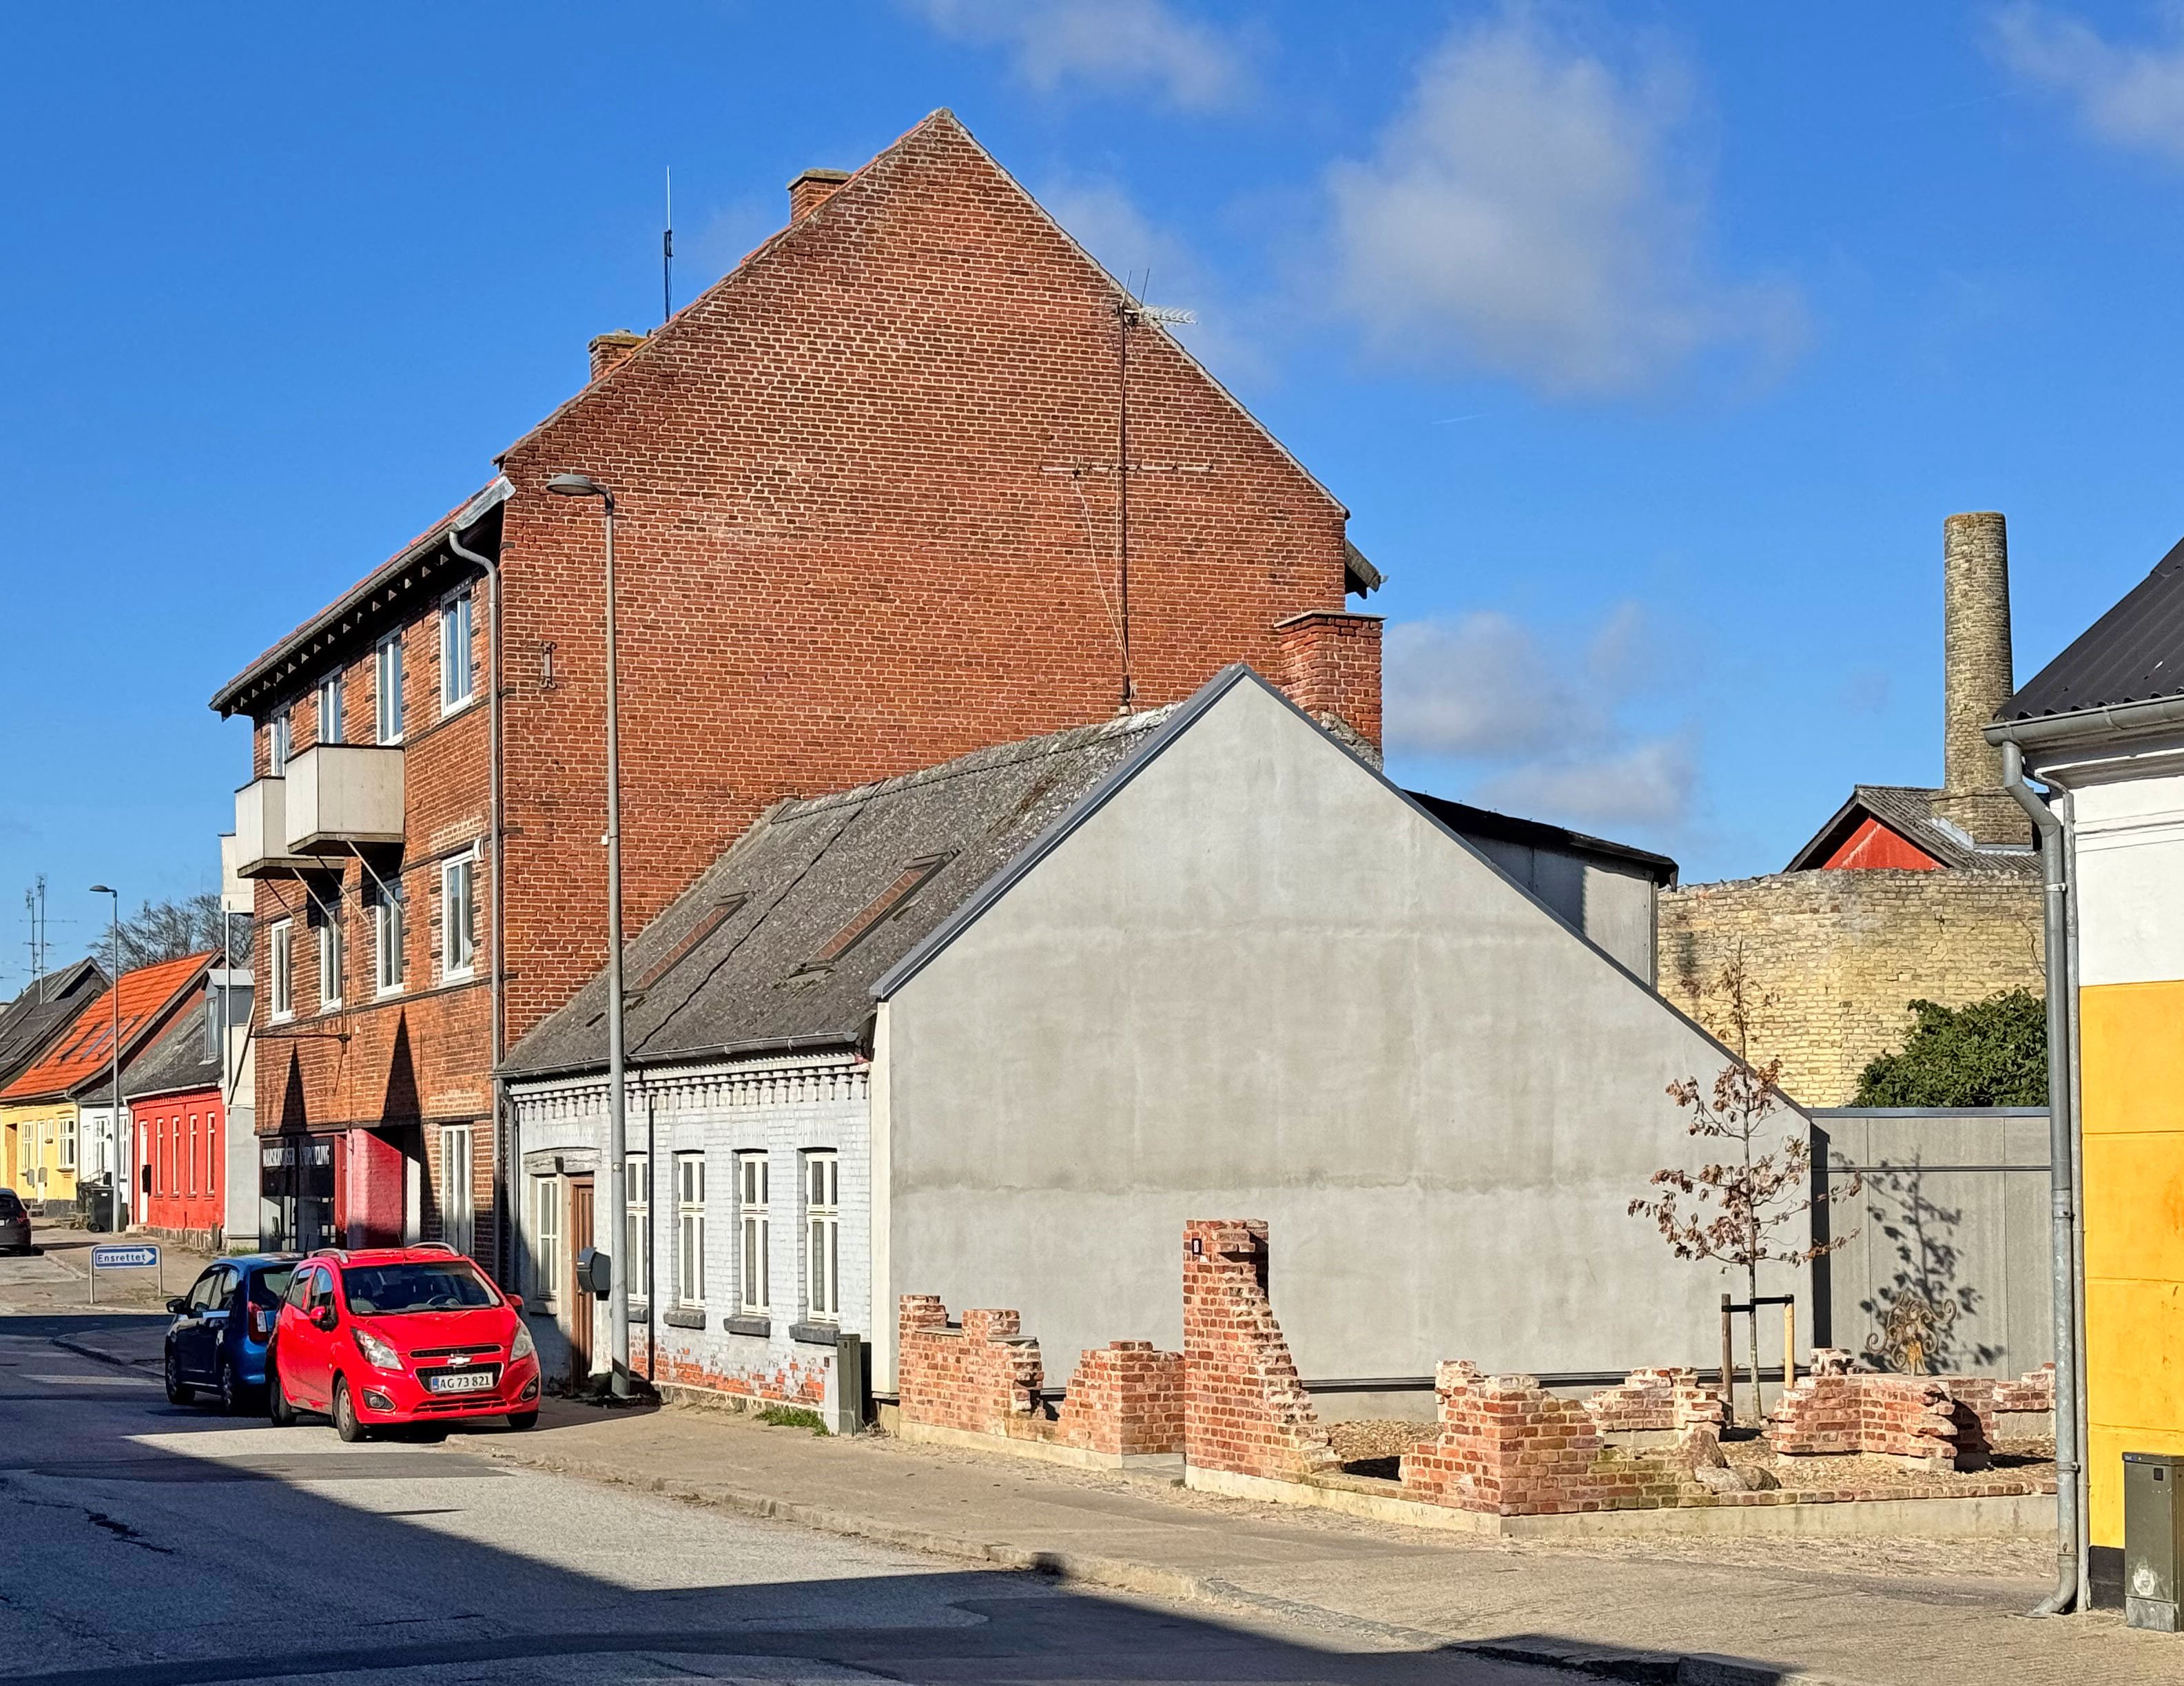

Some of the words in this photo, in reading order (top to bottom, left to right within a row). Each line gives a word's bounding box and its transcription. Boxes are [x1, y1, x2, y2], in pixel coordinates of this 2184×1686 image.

[97, 1253, 146, 1263] Ensrettet
[440, 1378, 455, 1388] AG
[457, 1377, 469, 1388] 73
[472, 1375, 490, 1386] 821
